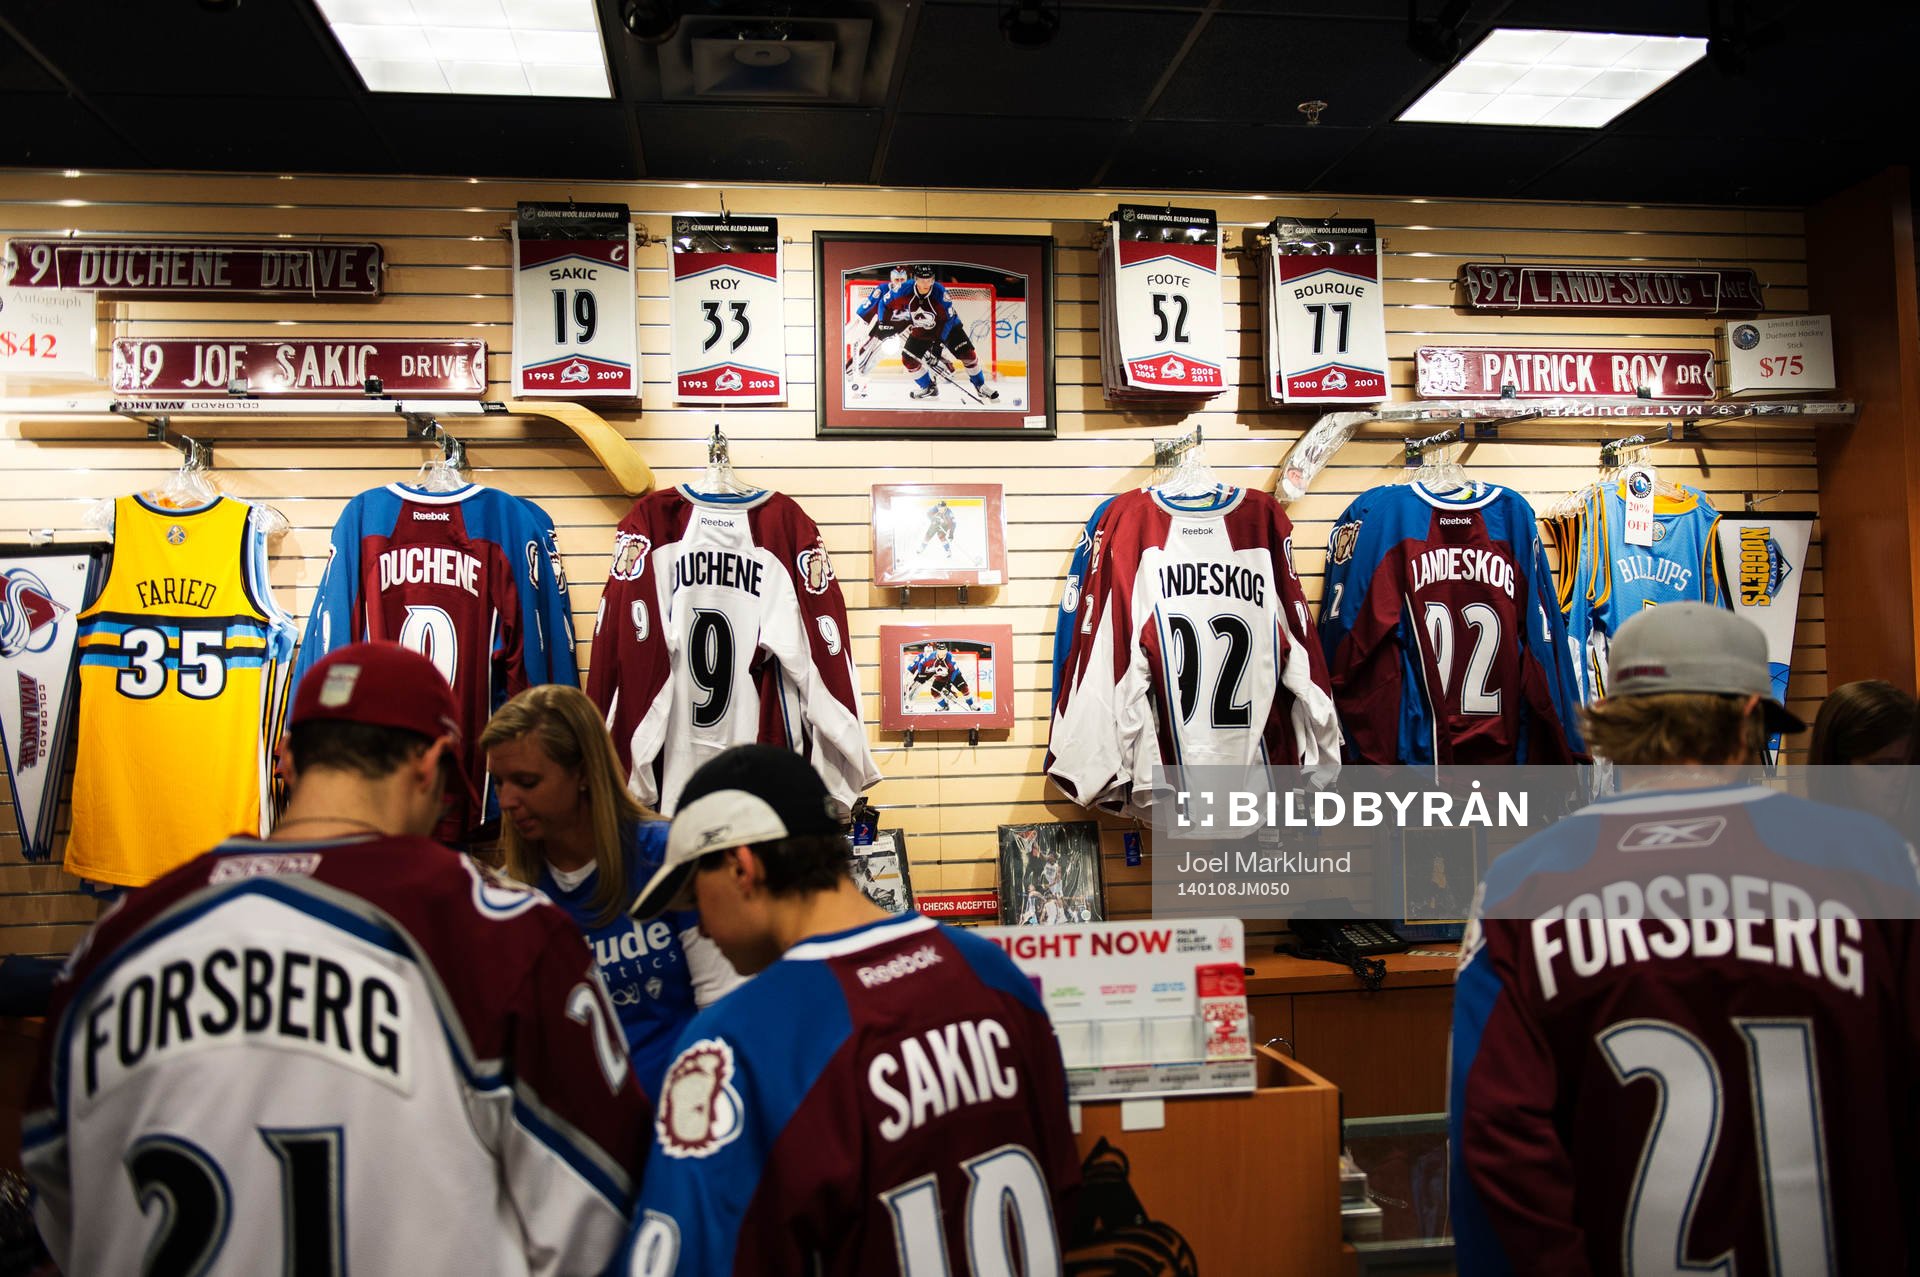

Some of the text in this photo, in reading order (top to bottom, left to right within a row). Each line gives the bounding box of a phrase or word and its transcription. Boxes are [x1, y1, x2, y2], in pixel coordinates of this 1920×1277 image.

[597, 211, 619, 219] BANNER
[1136, 213, 1158, 221] GENUINE
[714, 224, 730, 232] WOOL
[30, 244, 358, 289] 9 DUCHENE DRIVE
[549, 268, 597, 281] SAKIC
[709, 279, 741, 290] ROY
[1146, 273, 1191, 289] FOOTE
[1481, 270, 1517, 303] 92
[1528, 271, 1693, 304] LANDESKOG
[13, 291, 81, 309] Autograph
[1293, 283, 1365, 300] BOURQUE
[31, 313, 63, 327] Stick
[551, 288, 598, 345] 19
[1150, 291, 1191, 344] 52
[1768, 318, 1821, 328] Limited Edition
[701, 300, 751, 354] 33
[1303, 302, 1352, 355] 77
[1798, 329, 1824, 338] Hockey
[0, 331, 57, 358] $42
[131, 344, 470, 388] 19 JOE SAKIC DRIVE
[528, 372, 555, 380] 1995
[597, 371, 624, 379] 2009
[1133, 363, 1158, 374] 1995-
[1135, 370, 1157, 380] 2004
[1191, 367, 1218, 375] 2008-
[1482, 353, 1594, 393] PATRICK
[1611, 355, 1668, 393] ROY
[1676, 365, 1702, 385] DR
[1760, 355, 1804, 378] $75
[682, 380, 708, 389] 1995
[748, 380, 775, 388] 2003
[1191, 375, 1215, 383] 2011
[1293, 381, 1318, 389] 2000
[1354, 379, 1379, 387] 2001
[117, 401, 186, 410] AVALANC
[1641, 405, 1702, 416] MATT
[413, 512, 450, 521] Reebok
[1628, 502, 1650, 514] 20%
[701, 517, 735, 528] Reebok
[1182, 527, 1214, 535] Reebok
[1440, 517, 1472, 525] Reebok
[1628, 520, 1650, 532] OFF
[379, 547, 482, 598] DUCHENE
[1412, 548, 1516, 600] LANDESKOG
[1617, 556, 1693, 592] BILLUPS
[1740, 527, 1771, 606] NUGGETS
[1766, 541, 1778, 596] DENVER
[136, 577, 217, 610] FARIED
[1159, 562, 1265, 609] NDESKOG
[631, 600, 650, 642] 9
[815, 614, 842, 656] 9
[116, 625, 228, 700] 35
[688, 607, 736, 728] 9
[17, 669, 40, 777] AVALANCHE
[38, 684, 48, 758] COLORADO
[922, 901, 955, 911] CHECKS
[956, 900, 998, 911] ACCEPTED
[988, 929, 1173, 960] IGHT NOW
[1531, 873, 1866, 1000] FORSBERG
[855, 944, 944, 990] Reebok
[84, 947, 401, 1098] FORSBERG
[868, 1018, 1019, 1143] SAKIC
[1595, 1016, 1838, 1277] 21
[124, 1125, 349, 1277] 21
